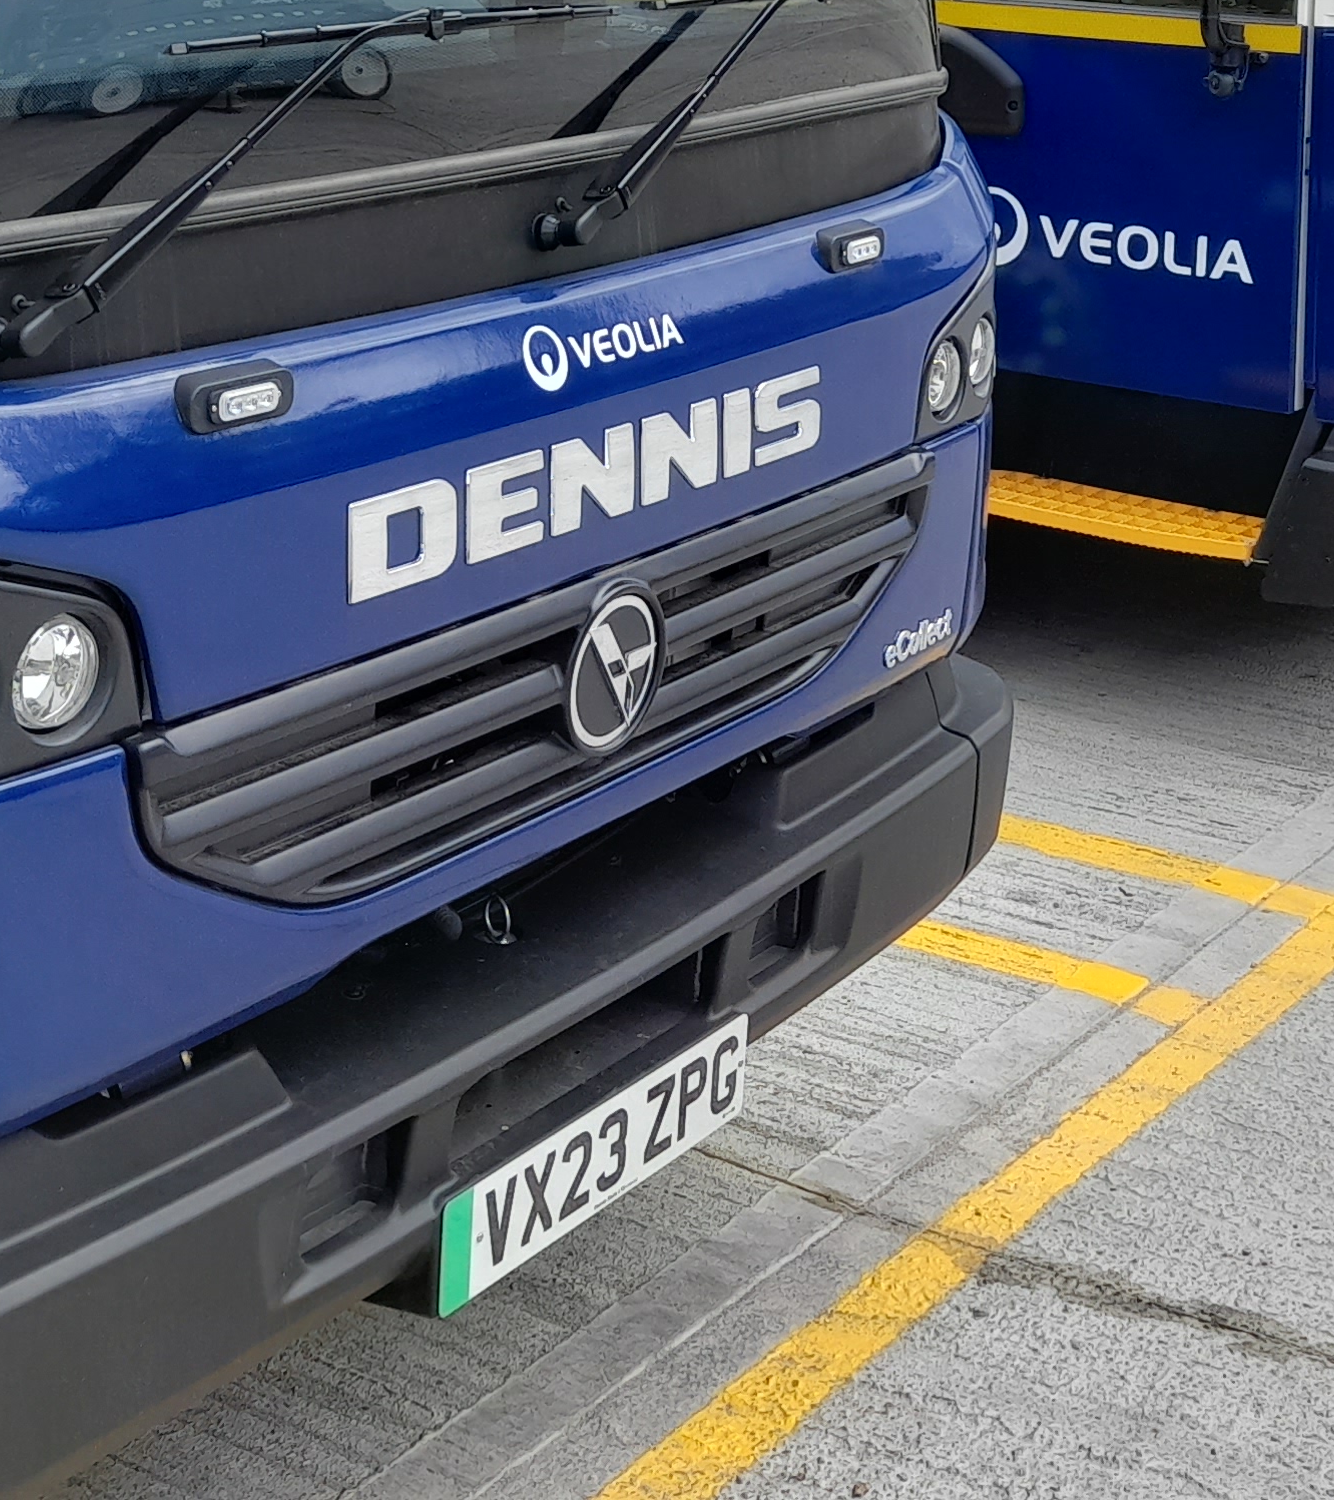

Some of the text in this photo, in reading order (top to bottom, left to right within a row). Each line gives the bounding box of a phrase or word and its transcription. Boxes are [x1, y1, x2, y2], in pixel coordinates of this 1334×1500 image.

[1040, 217, 1254, 284] VEOLIA
[568, 313, 684, 371] VEOLIA
[347, 365, 822, 605] DENNIS
[883, 608, 954, 669] eCollect
[485, 1034, 739, 1267] VX23 ZPG
